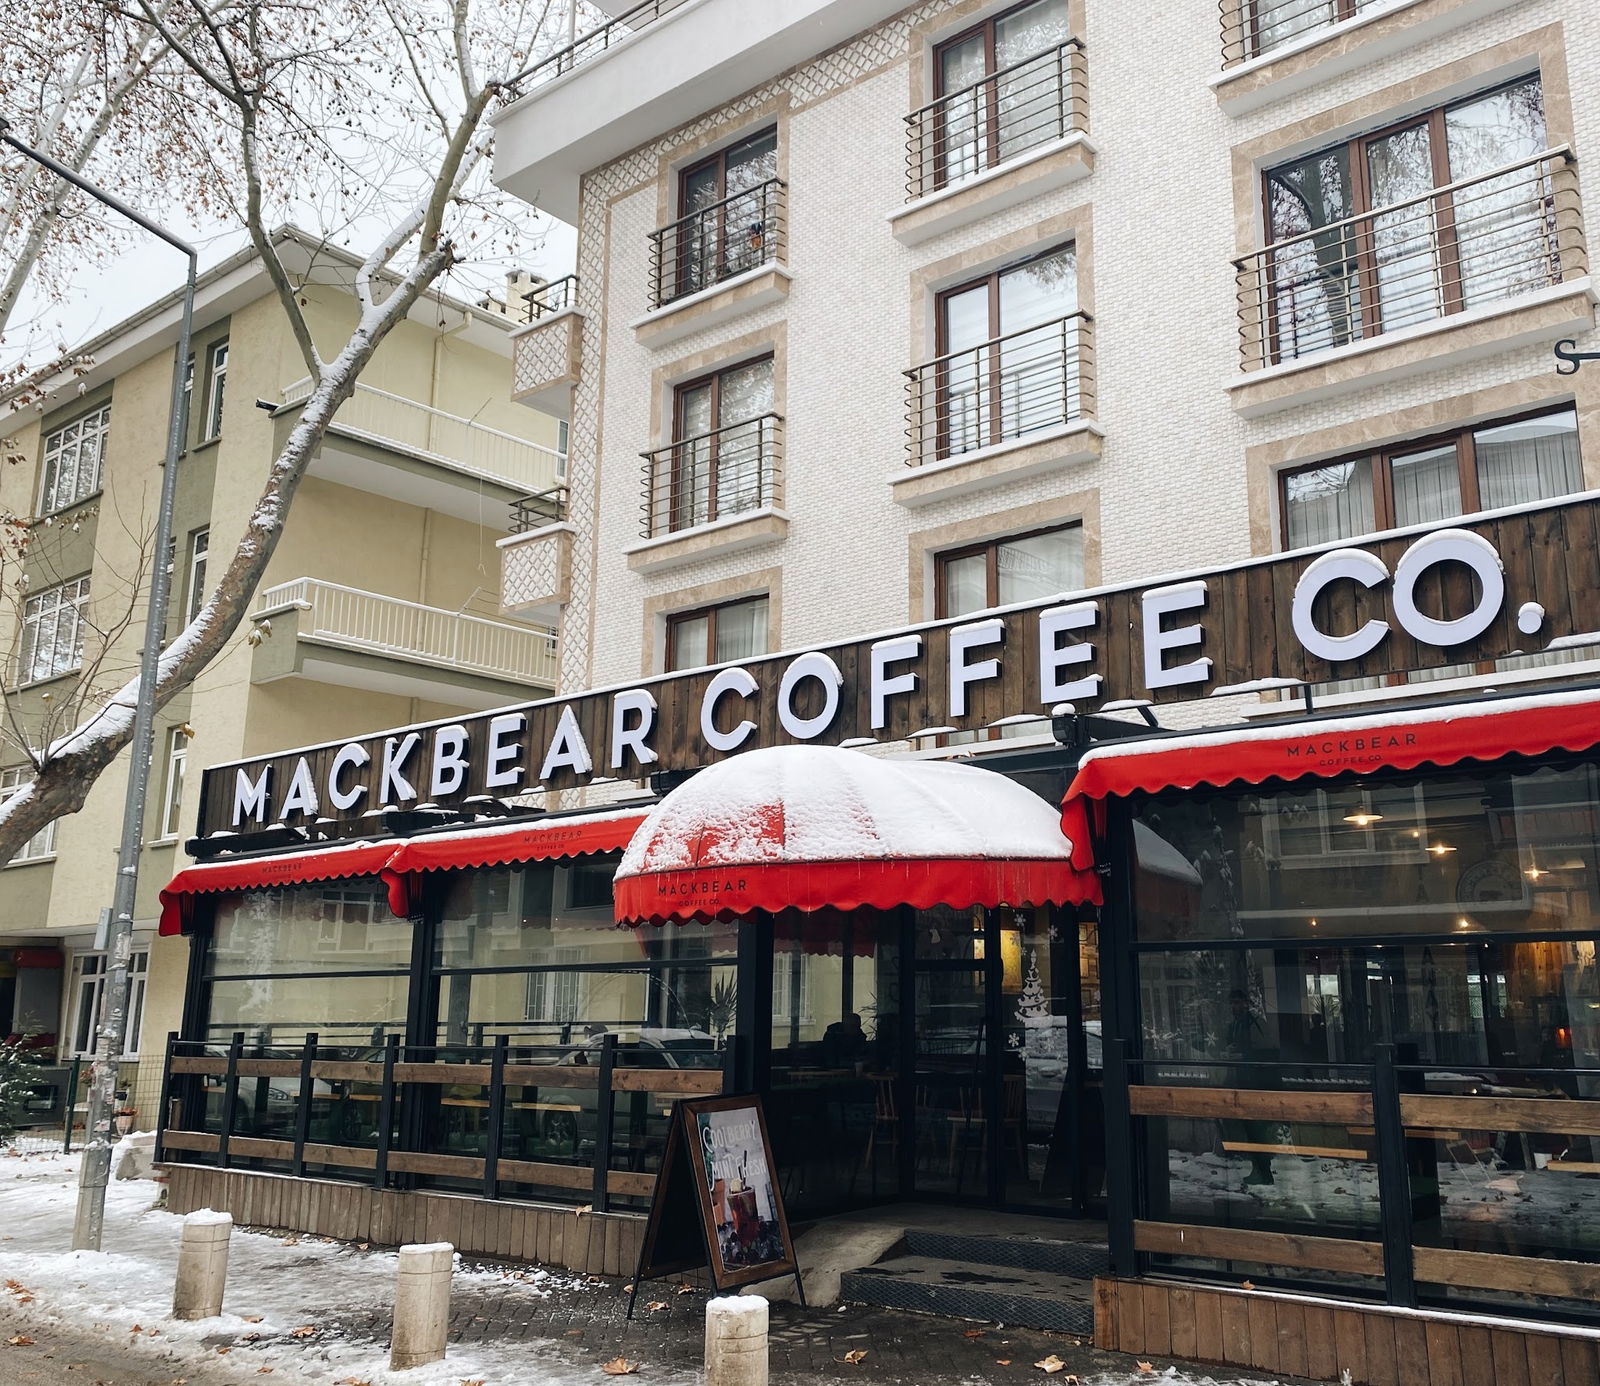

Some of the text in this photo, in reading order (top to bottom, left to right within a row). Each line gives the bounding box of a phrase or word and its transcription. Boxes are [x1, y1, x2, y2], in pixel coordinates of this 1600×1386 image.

[231, 528, 1545, 827] MACKBEAR COFFEE CO.
[1287, 733, 1417, 757] MACKBEAR
[1319, 756, 1365, 767] COFFEE
[524, 830, 582, 844] MACKBEAR
[658, 879, 747, 896] MACKBEAR
[679, 899, 707, 907] COFFEE
[703, 1120, 757, 1153] COOLBERRY
[710, 1153, 734, 1192] MINT
